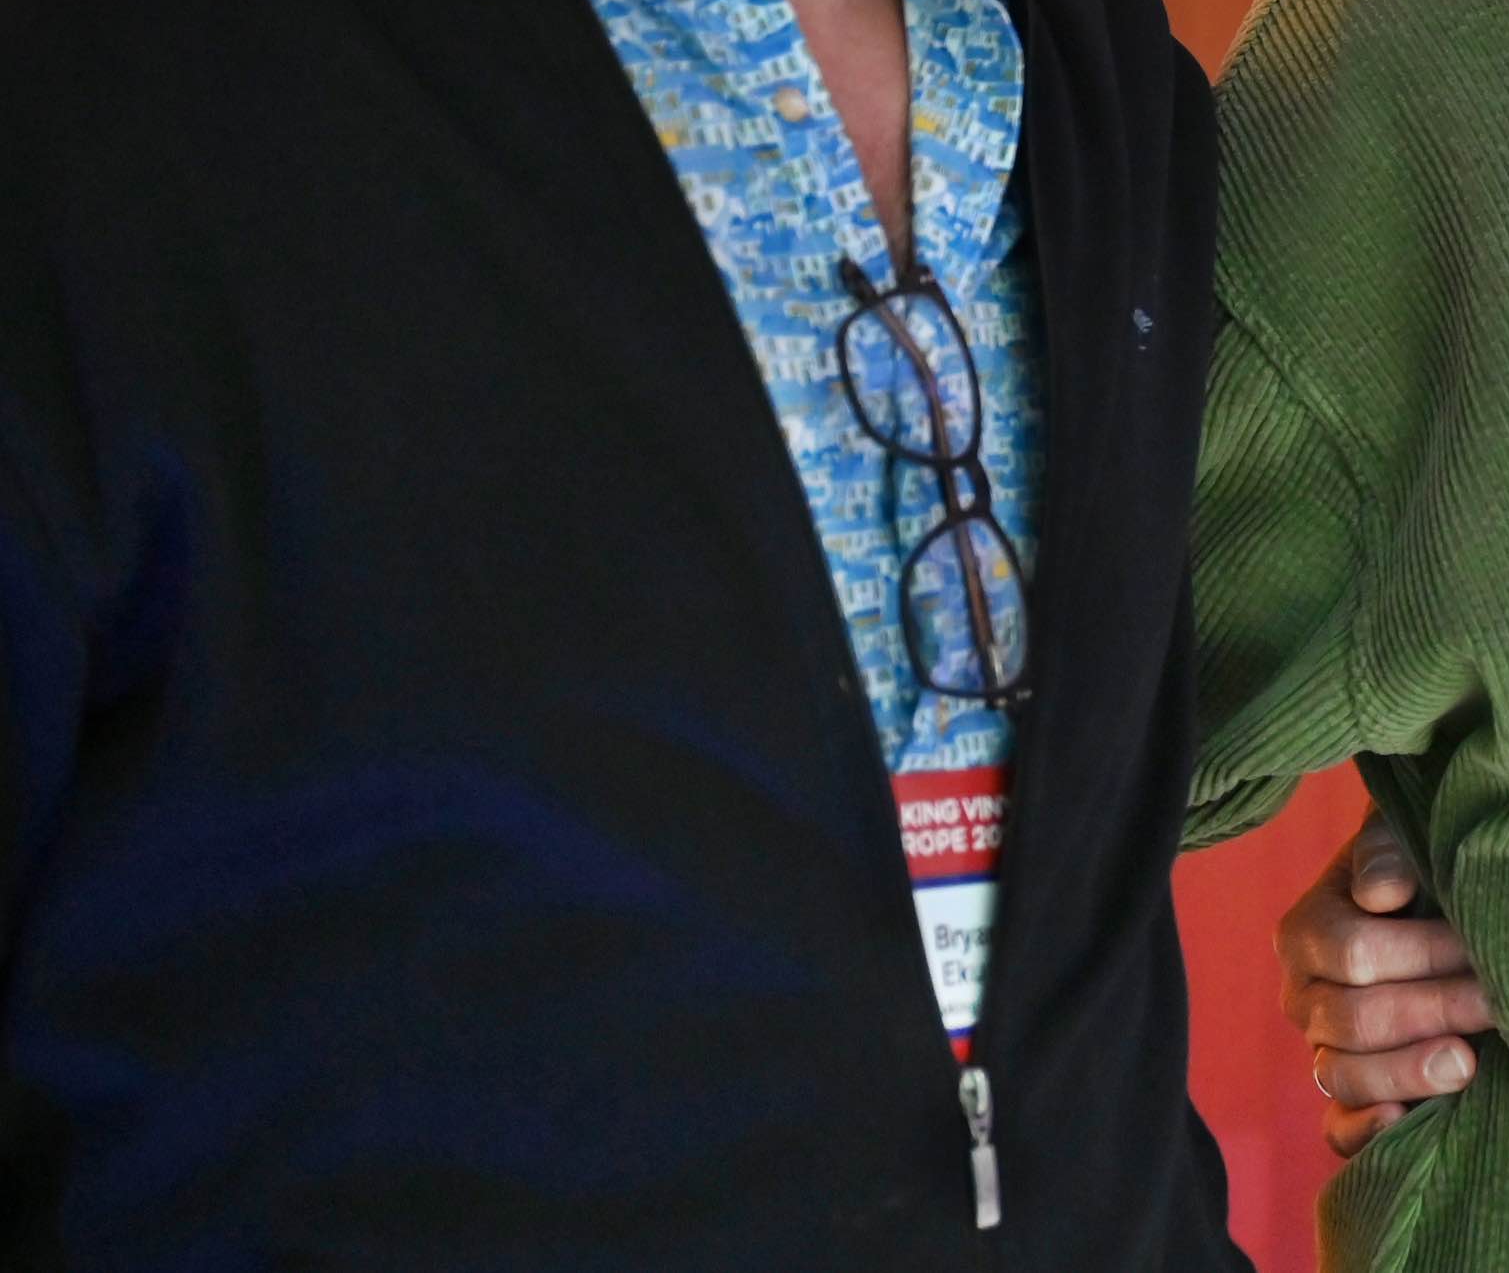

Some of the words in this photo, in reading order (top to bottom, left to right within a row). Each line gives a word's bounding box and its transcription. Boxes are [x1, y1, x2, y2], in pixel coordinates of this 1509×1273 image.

[901, 798, 961, 827] KING
[962, 795, 1005, 824] VIN
[902, 827, 968, 857] ROPE
[971, 824, 1001, 851] 20
[934, 924, 987, 954] Brya
